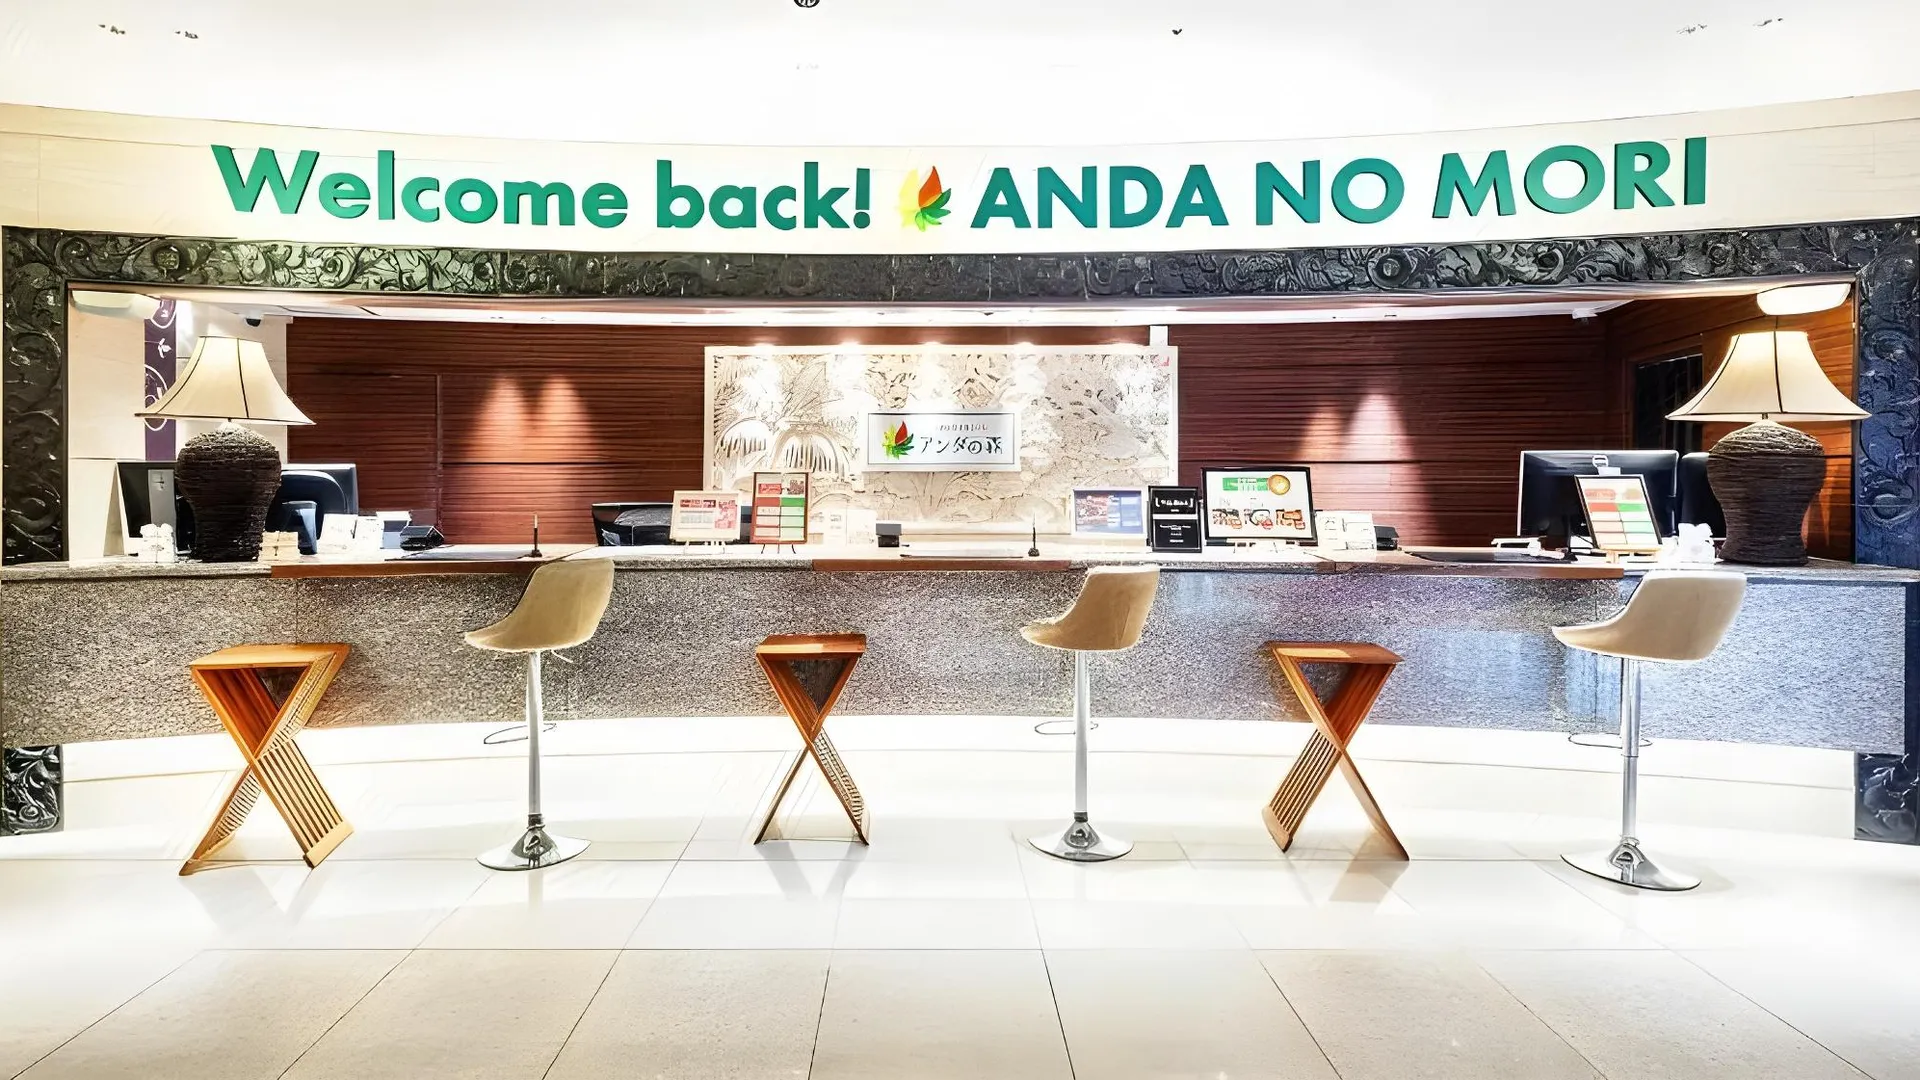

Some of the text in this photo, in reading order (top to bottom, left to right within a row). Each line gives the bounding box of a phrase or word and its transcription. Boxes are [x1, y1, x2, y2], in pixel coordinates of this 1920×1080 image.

[211, 136, 1708, 230] Welcome back! ANDA NO MORI
